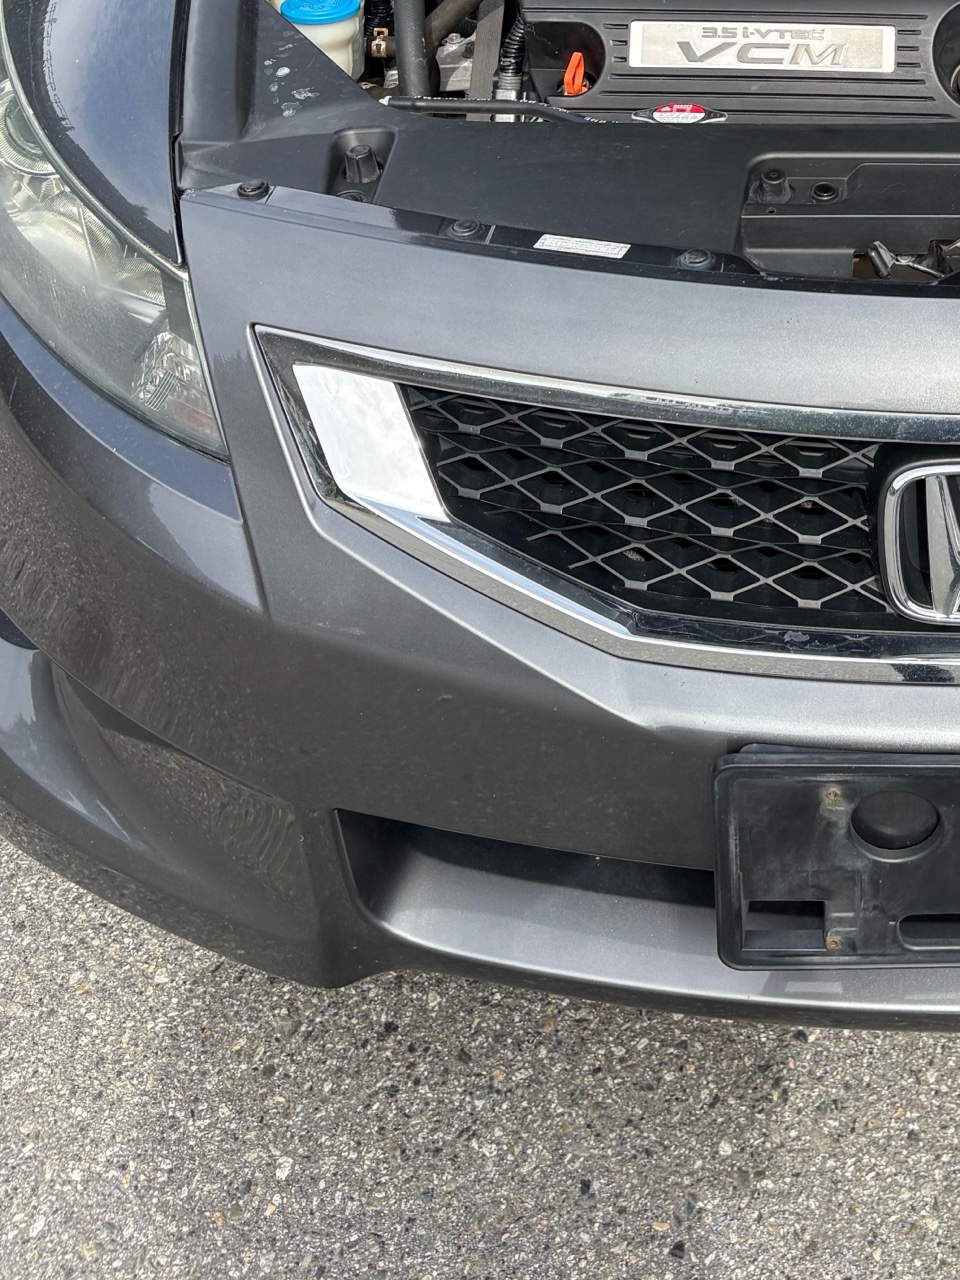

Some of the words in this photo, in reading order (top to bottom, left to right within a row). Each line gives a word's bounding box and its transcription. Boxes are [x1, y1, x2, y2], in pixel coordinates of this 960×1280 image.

[702, 26, 737, 39] 3.5
[743, 26, 825, 40] i-VTEC
[677, 41, 848, 65] VCM
